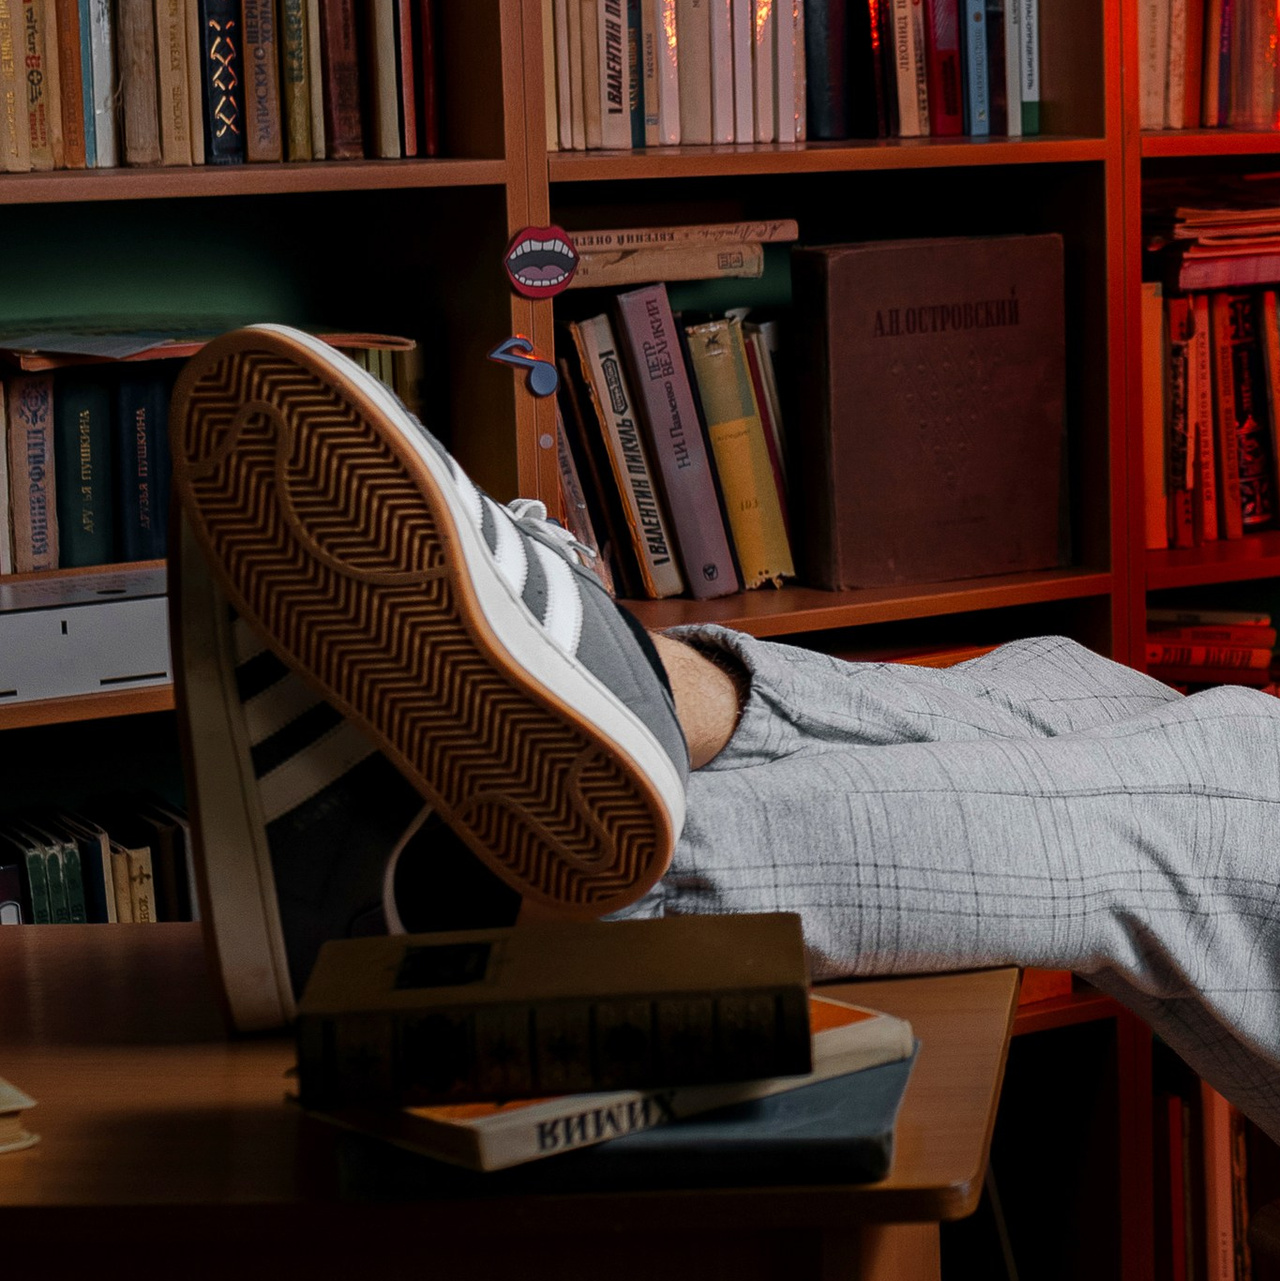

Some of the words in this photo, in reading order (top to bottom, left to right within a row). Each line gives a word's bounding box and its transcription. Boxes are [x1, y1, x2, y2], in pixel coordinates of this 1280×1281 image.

[23, 6, 41, 68] Загадка
[166, 23, 182, 70] КУЗЬМА
[252, 45, 265, 60] О
[605, 18, 623, 104] ВАЛЕНТИН
[645, 32, 653, 78] РАССКАЗЫ
[896, 14, 910, 71] ЛЕОНИД
[254, 63, 272, 141] ЗАПИСКИ
[571, 234, 612, 247] ОНЕГИ
[617, 231, 673, 245] ЕВГЕНИЙ
[642, 339, 662, 380] ПЕТР
[644, 297, 675, 377] ВЕЛИКИЙ
[1219, 345, 1231, 396] ПОВЕСТИ
[658, 379, 684, 437] Павленко
[79, 409, 91, 480] ПУШКИНА
[136, 407, 147, 476] ПУШКИНА
[616, 416, 645, 477] ПИКУЛЬ
[672, 438, 691, 468] Н.И.
[26, 427, 49, 554] КОППЕРФИЛД
[81, 486, 94, 533] ДРУЬЯ
[138, 482, 149, 528] ДРУЗЬЯ
[631, 474, 667, 557] ВАЛЕНТИН
[533, 1089, 681, 1152] ХИМИЯ
